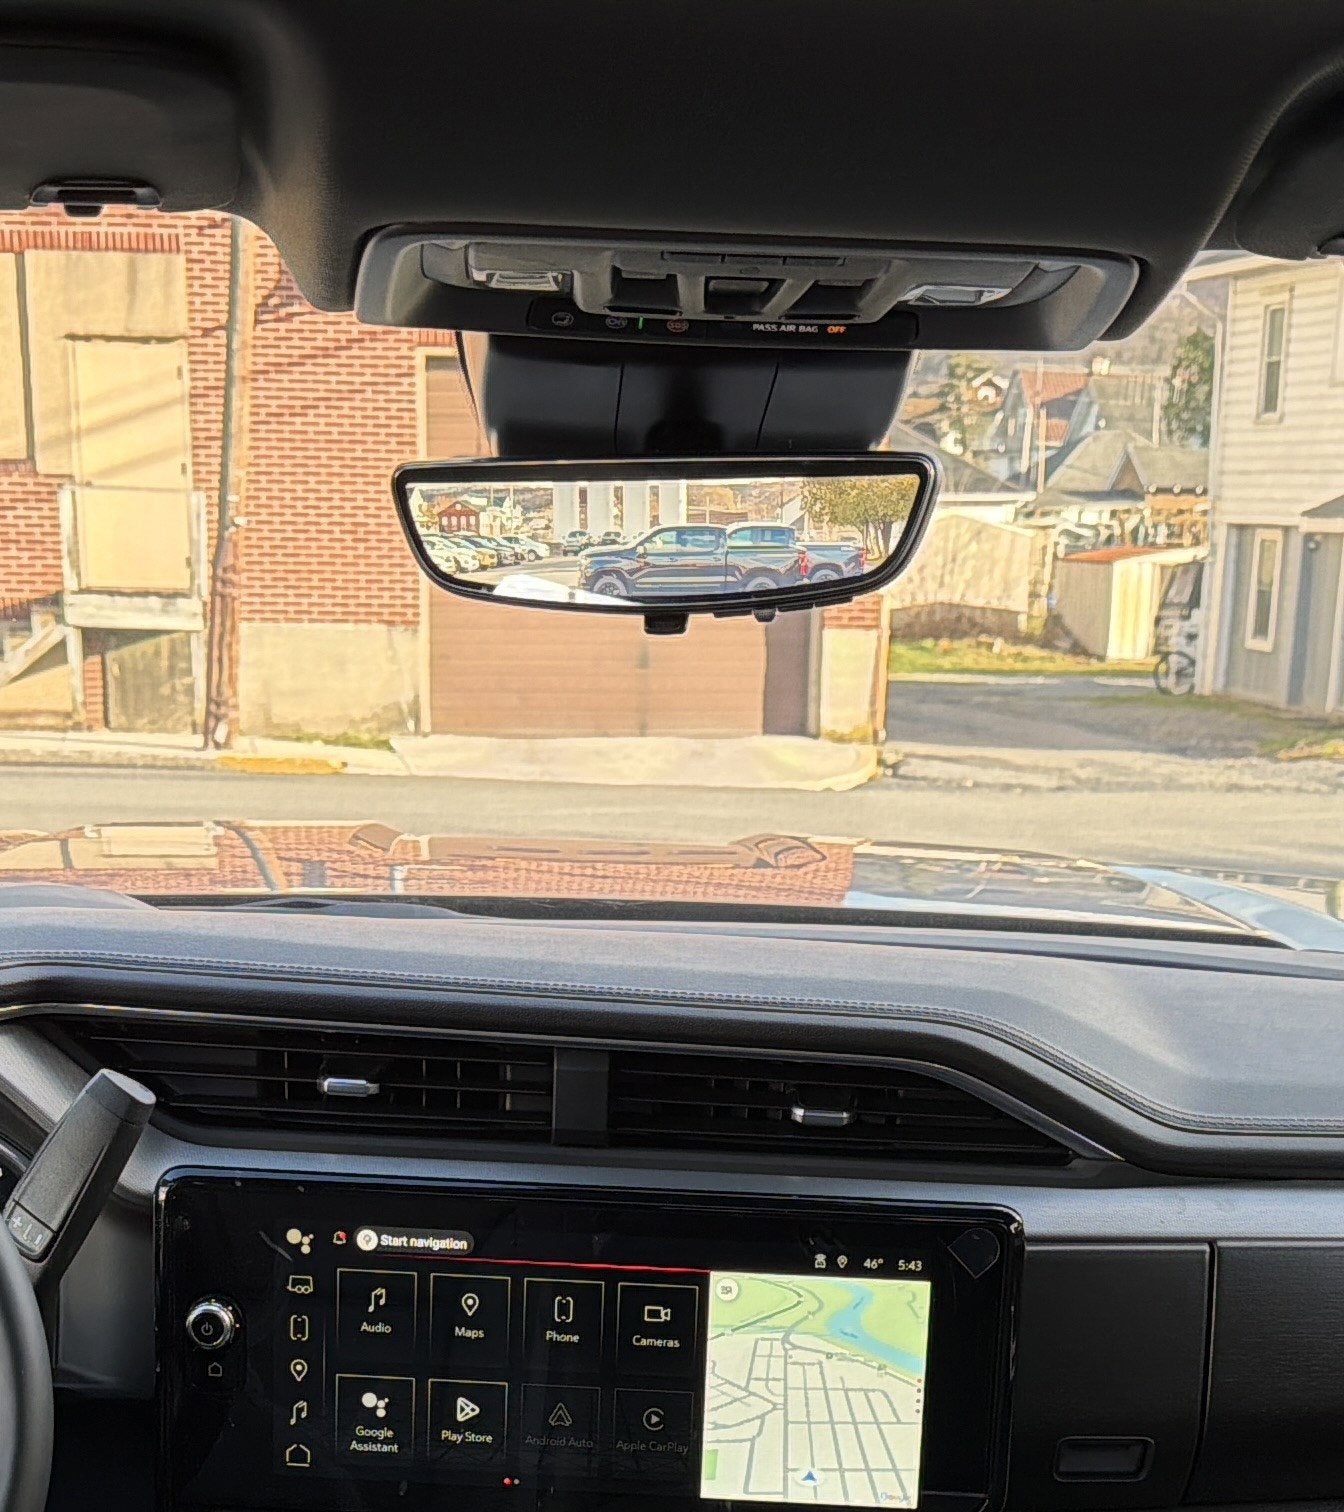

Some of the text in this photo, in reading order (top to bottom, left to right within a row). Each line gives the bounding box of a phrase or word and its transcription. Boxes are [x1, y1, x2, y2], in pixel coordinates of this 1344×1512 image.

[752, 323, 847, 334] PASS AIR BAG OFF
[380, 1234, 468, 1251] Start navigation
[897, 1259, 923, 1272] 5:43
[360, 1321, 392, 1333] Audio
[454, 1326, 485, 1340] Maps
[545, 1330, 580, 1343] Phone
[632, 1335, 680, 1348] Cameras
[355, 1425, 394, 1440] Google
[441, 1430, 493, 1444] Play Store
[349, 1440, 399, 1453] Assistant
[525, 1434, 594, 1448] Android Auto
[616, 1440, 689, 1456] Apple CarPlay
